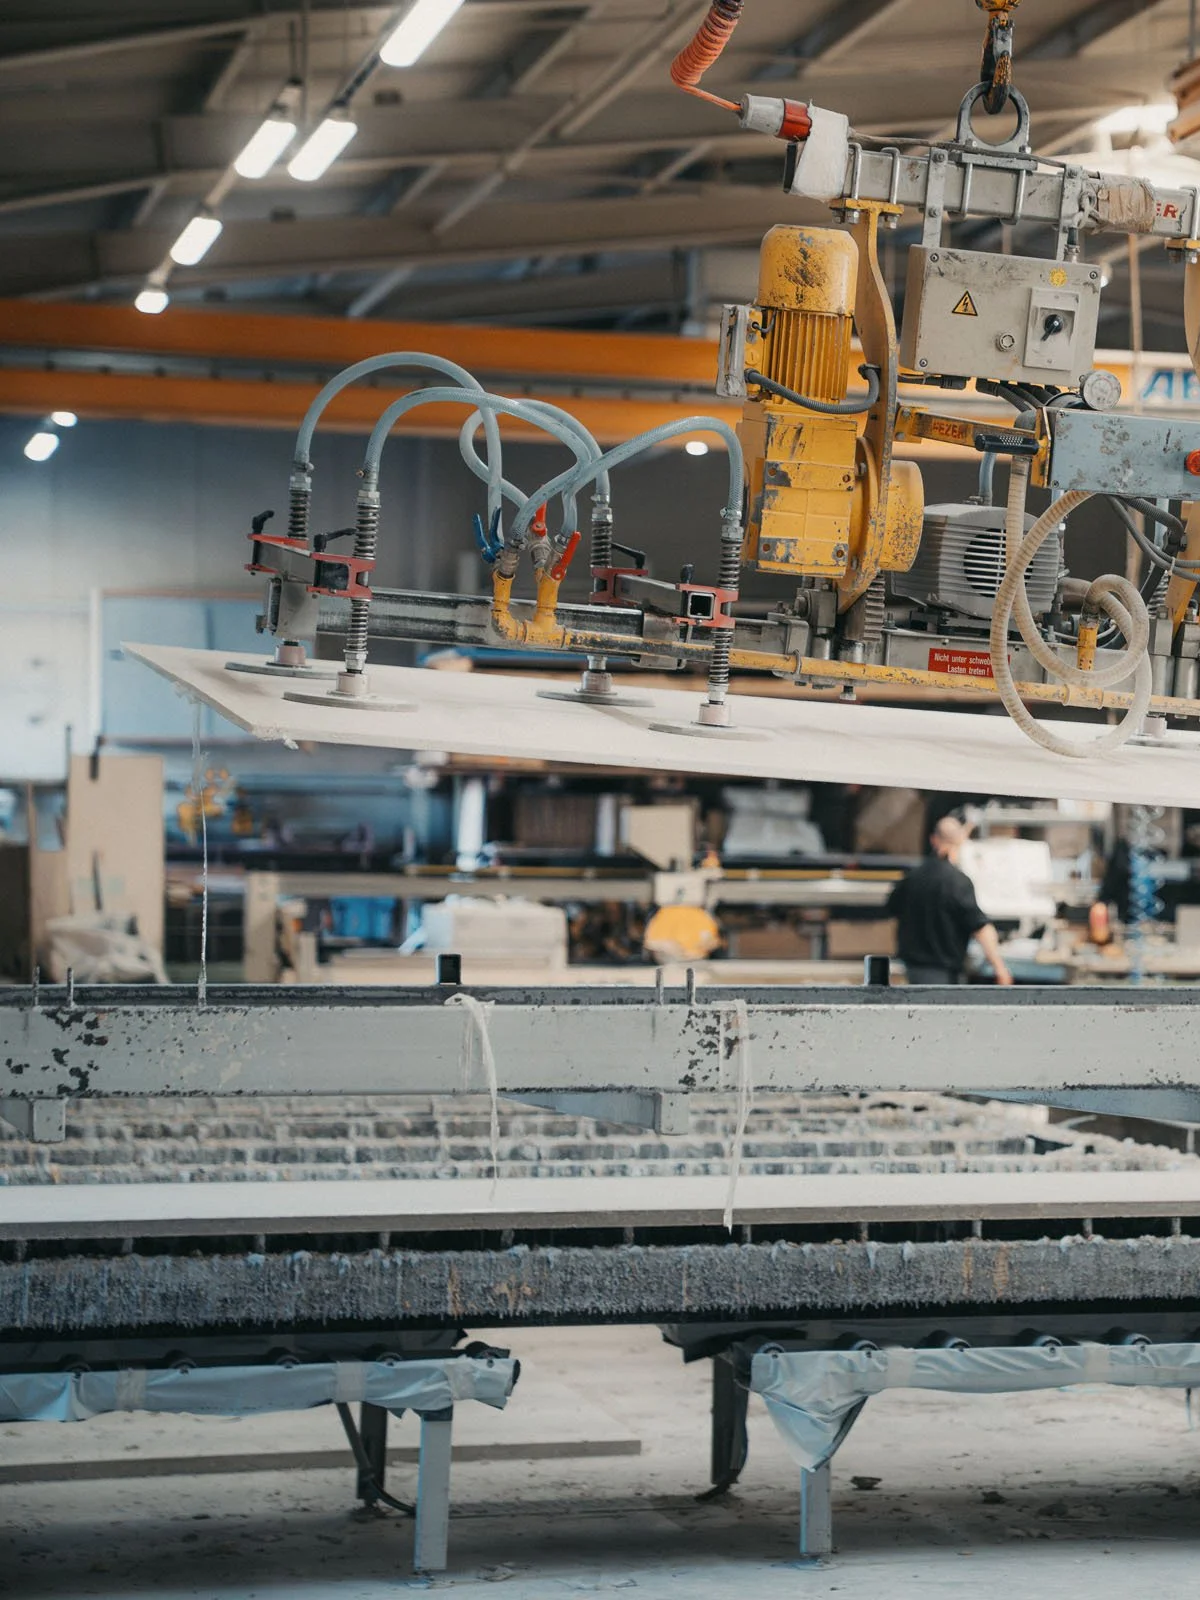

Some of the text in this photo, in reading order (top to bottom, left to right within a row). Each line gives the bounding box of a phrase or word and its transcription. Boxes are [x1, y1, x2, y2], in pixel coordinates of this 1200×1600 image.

[934, 653, 949, 661] Nicht
[947, 665, 966, 673] Lasten
[968, 667, 986, 675] treten
